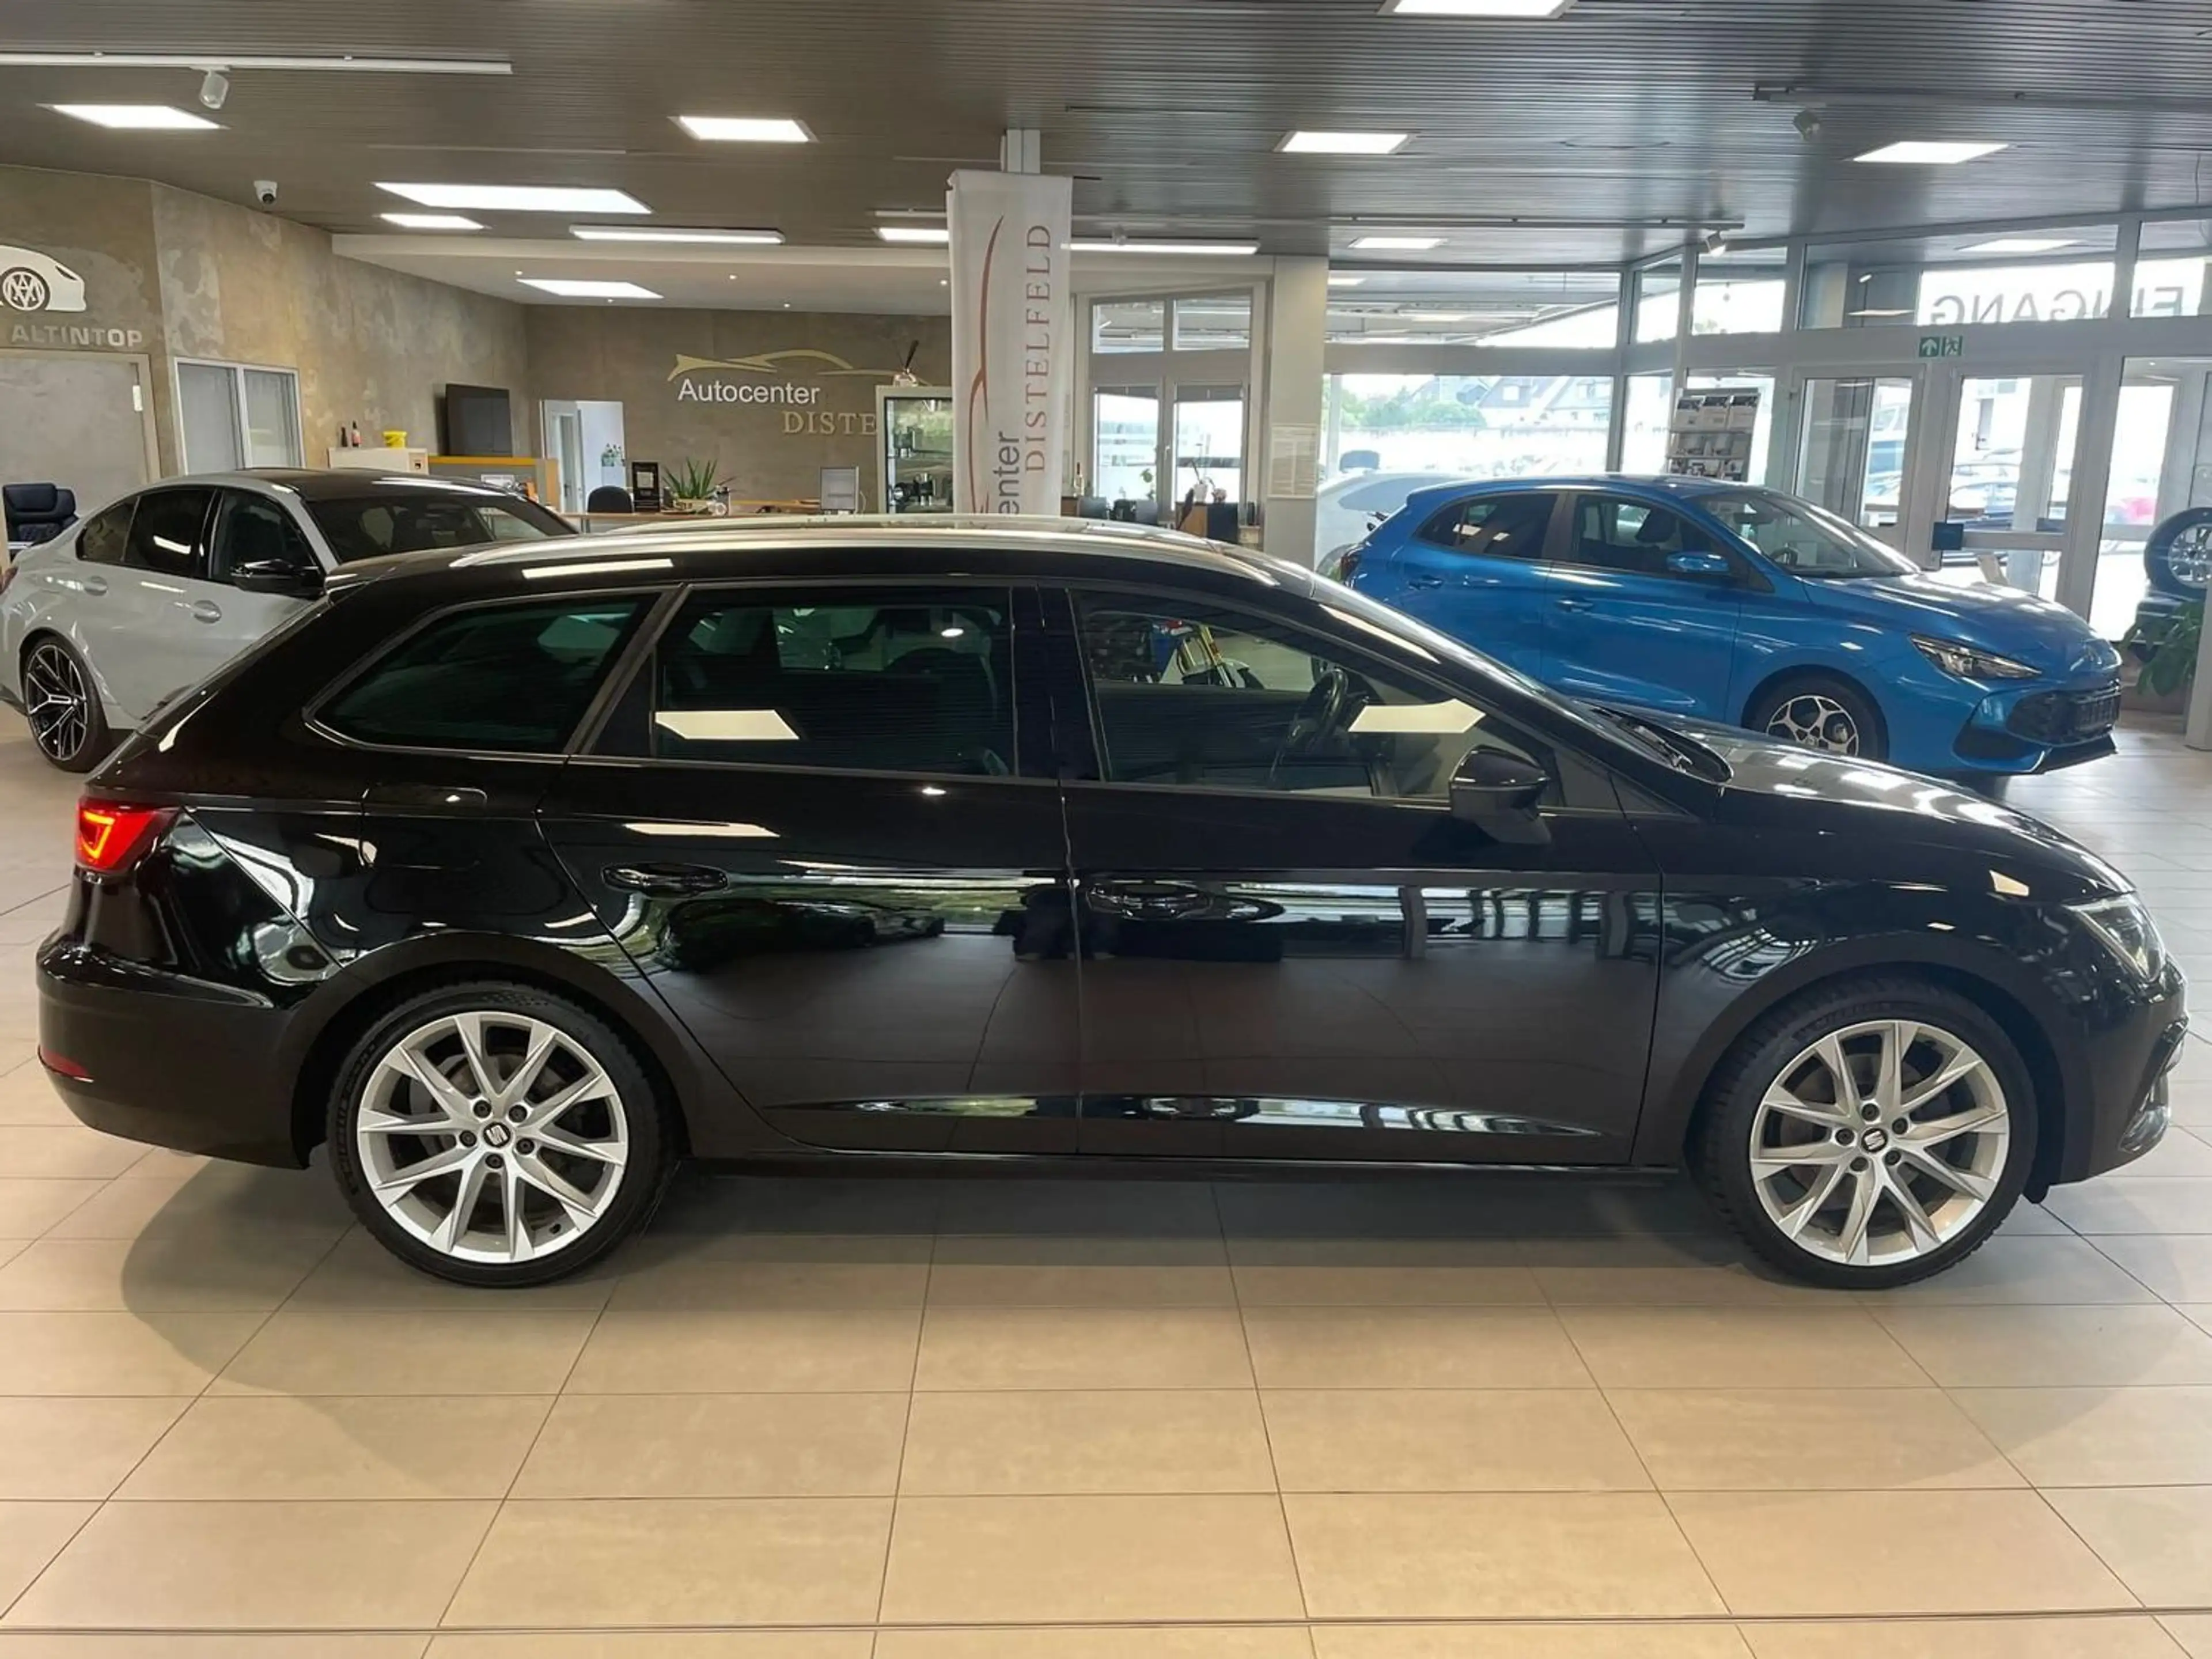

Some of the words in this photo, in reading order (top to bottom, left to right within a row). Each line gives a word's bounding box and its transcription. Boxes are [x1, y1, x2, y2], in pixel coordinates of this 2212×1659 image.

[11, 324, 143, 347] ALTINTOP
[1025, 224, 1051, 473] DISTELFELD
[677, 378, 820, 404] Autocenter
